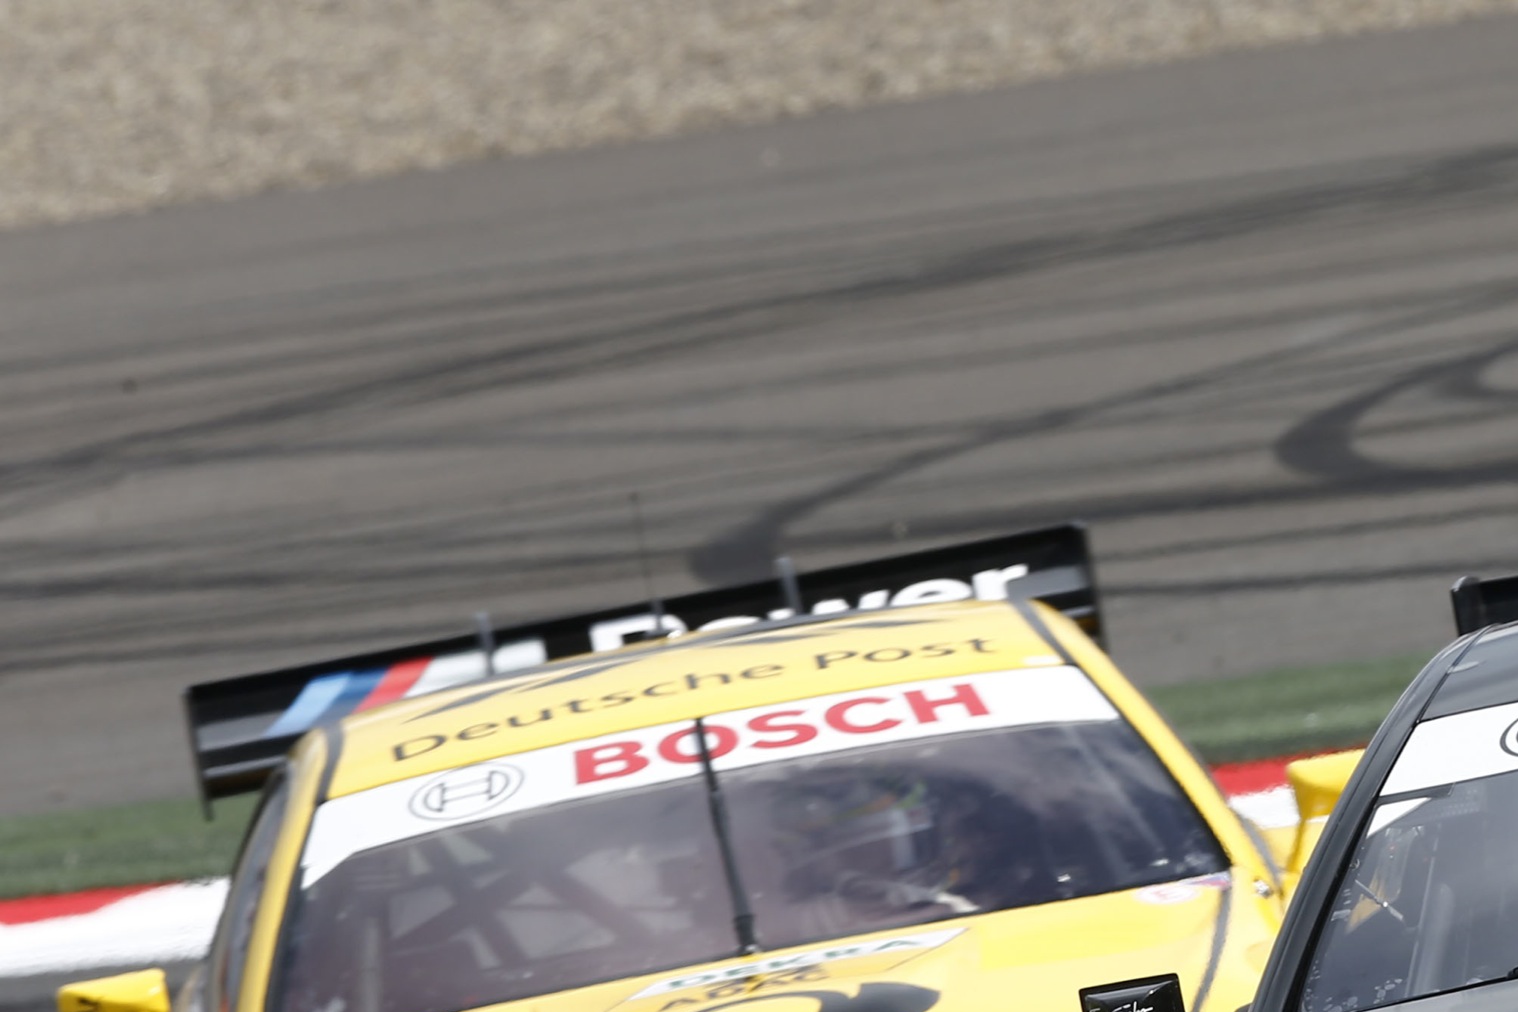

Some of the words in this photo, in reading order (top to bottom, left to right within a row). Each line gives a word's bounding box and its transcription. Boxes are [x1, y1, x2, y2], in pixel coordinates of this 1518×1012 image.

[392, 660, 785, 763] Deutsche
[813, 635, 998, 672] Post
[574, 684, 991, 785] BOSCH
